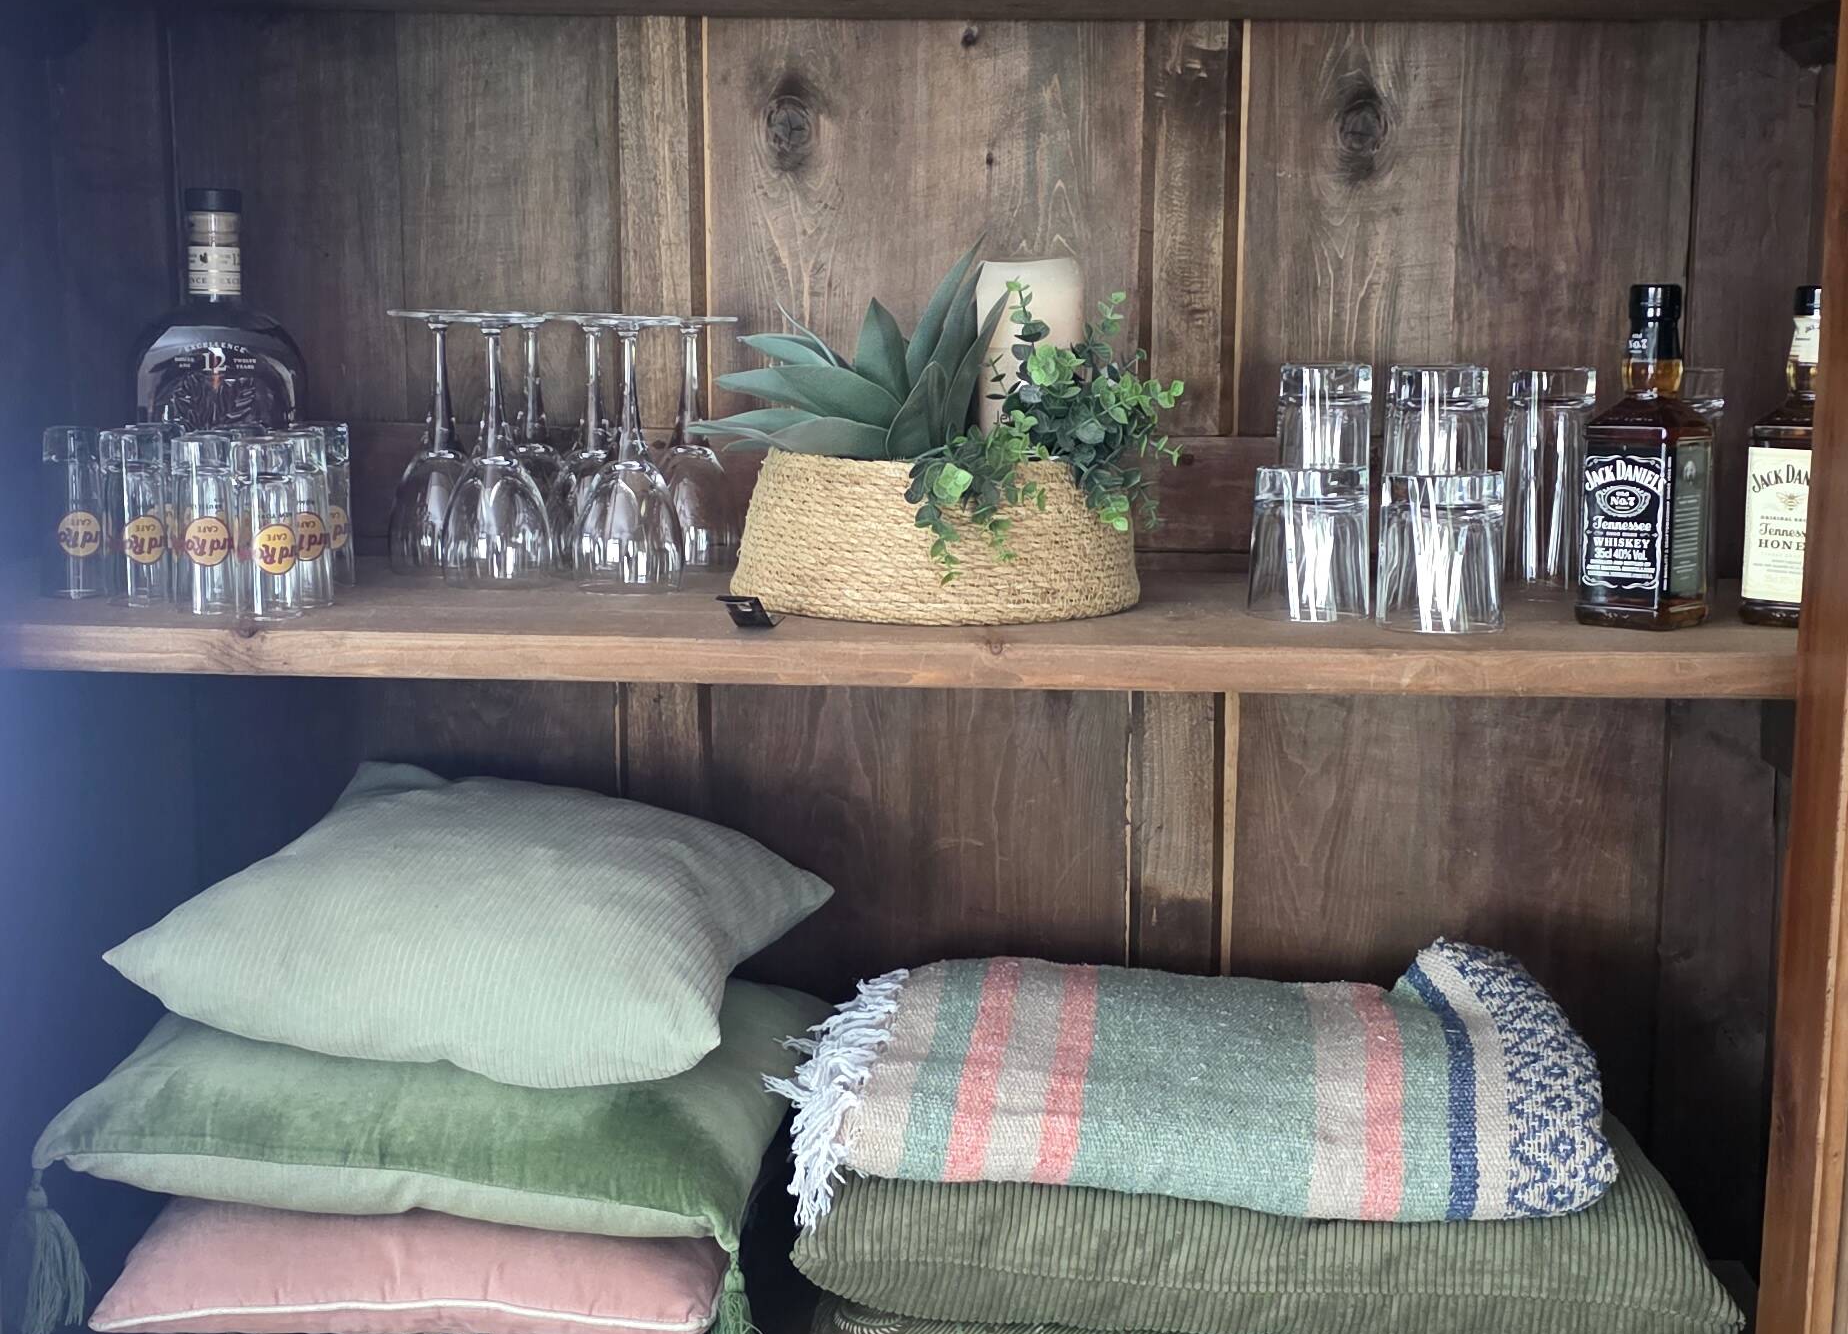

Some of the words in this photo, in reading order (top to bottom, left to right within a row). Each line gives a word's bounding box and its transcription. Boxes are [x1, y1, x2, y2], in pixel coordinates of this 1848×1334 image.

[183, 341, 246, 354] EXCELLENCE
[202, 351, 227, 371] 12
[1585, 465, 1616, 491] JACK
[1752, 469, 1783, 493] JACK
[1593, 515, 1652, 532] Tennessee
[1593, 537, 1651, 549] WHISKEY
[1613, 548, 1631, 560] 40%
